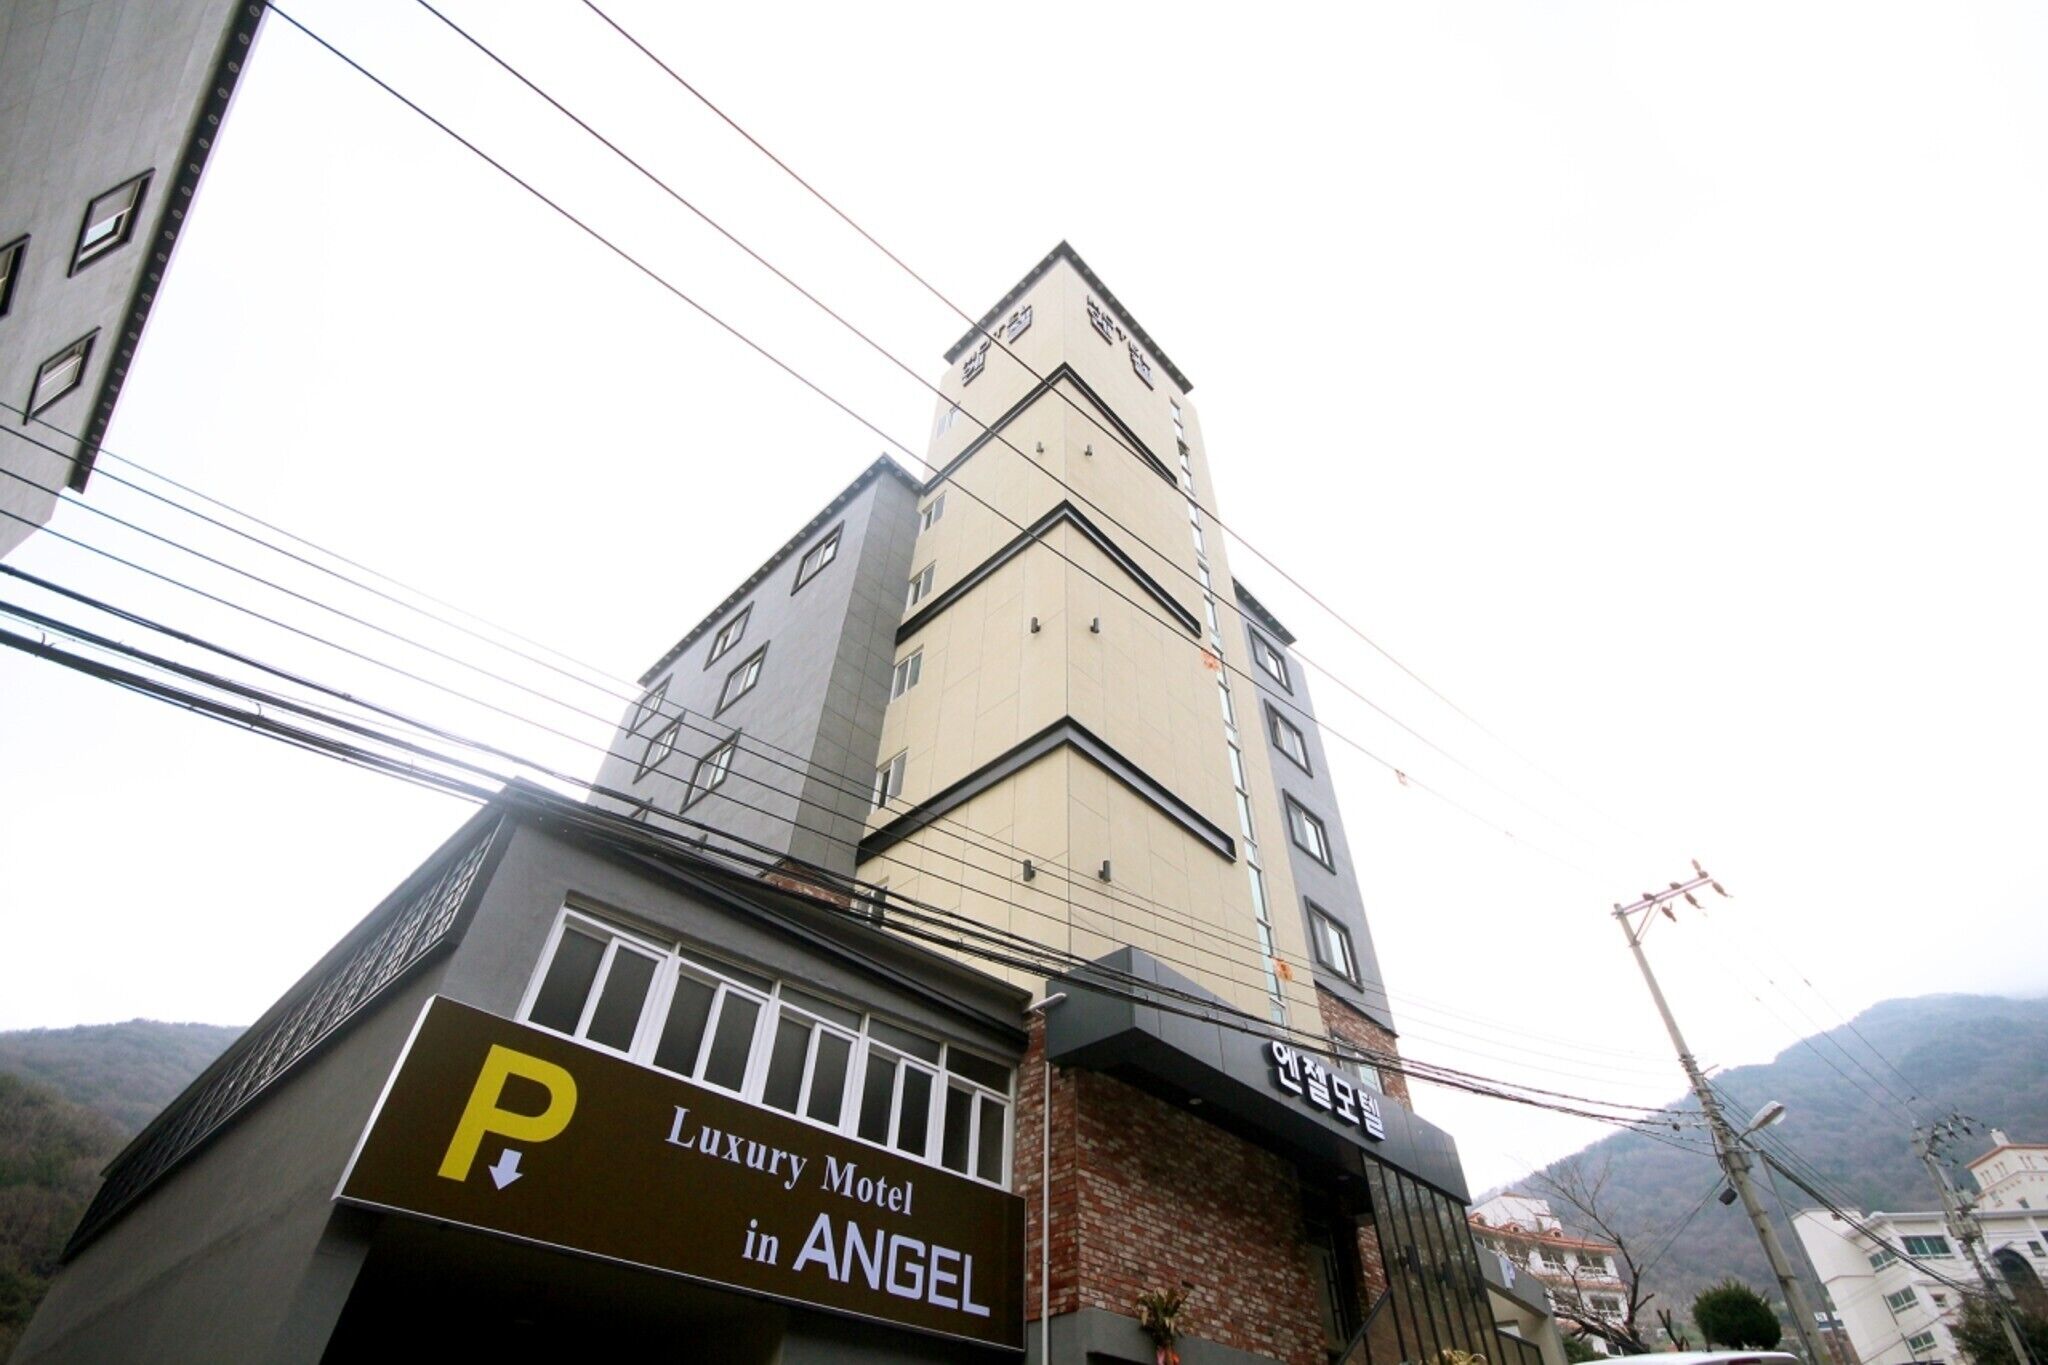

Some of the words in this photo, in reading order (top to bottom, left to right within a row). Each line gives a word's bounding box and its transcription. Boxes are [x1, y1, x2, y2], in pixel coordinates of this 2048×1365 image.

[437, 1043, 578, 1182] P
[1271, 1040, 1386, 1141] 엔젤모텔
[665, 1105, 808, 1190] Luxury
[821, 1154, 914, 1216] Motel
[742, 1218, 779, 1265] in
[792, 1212, 990, 1317] ANGEL
